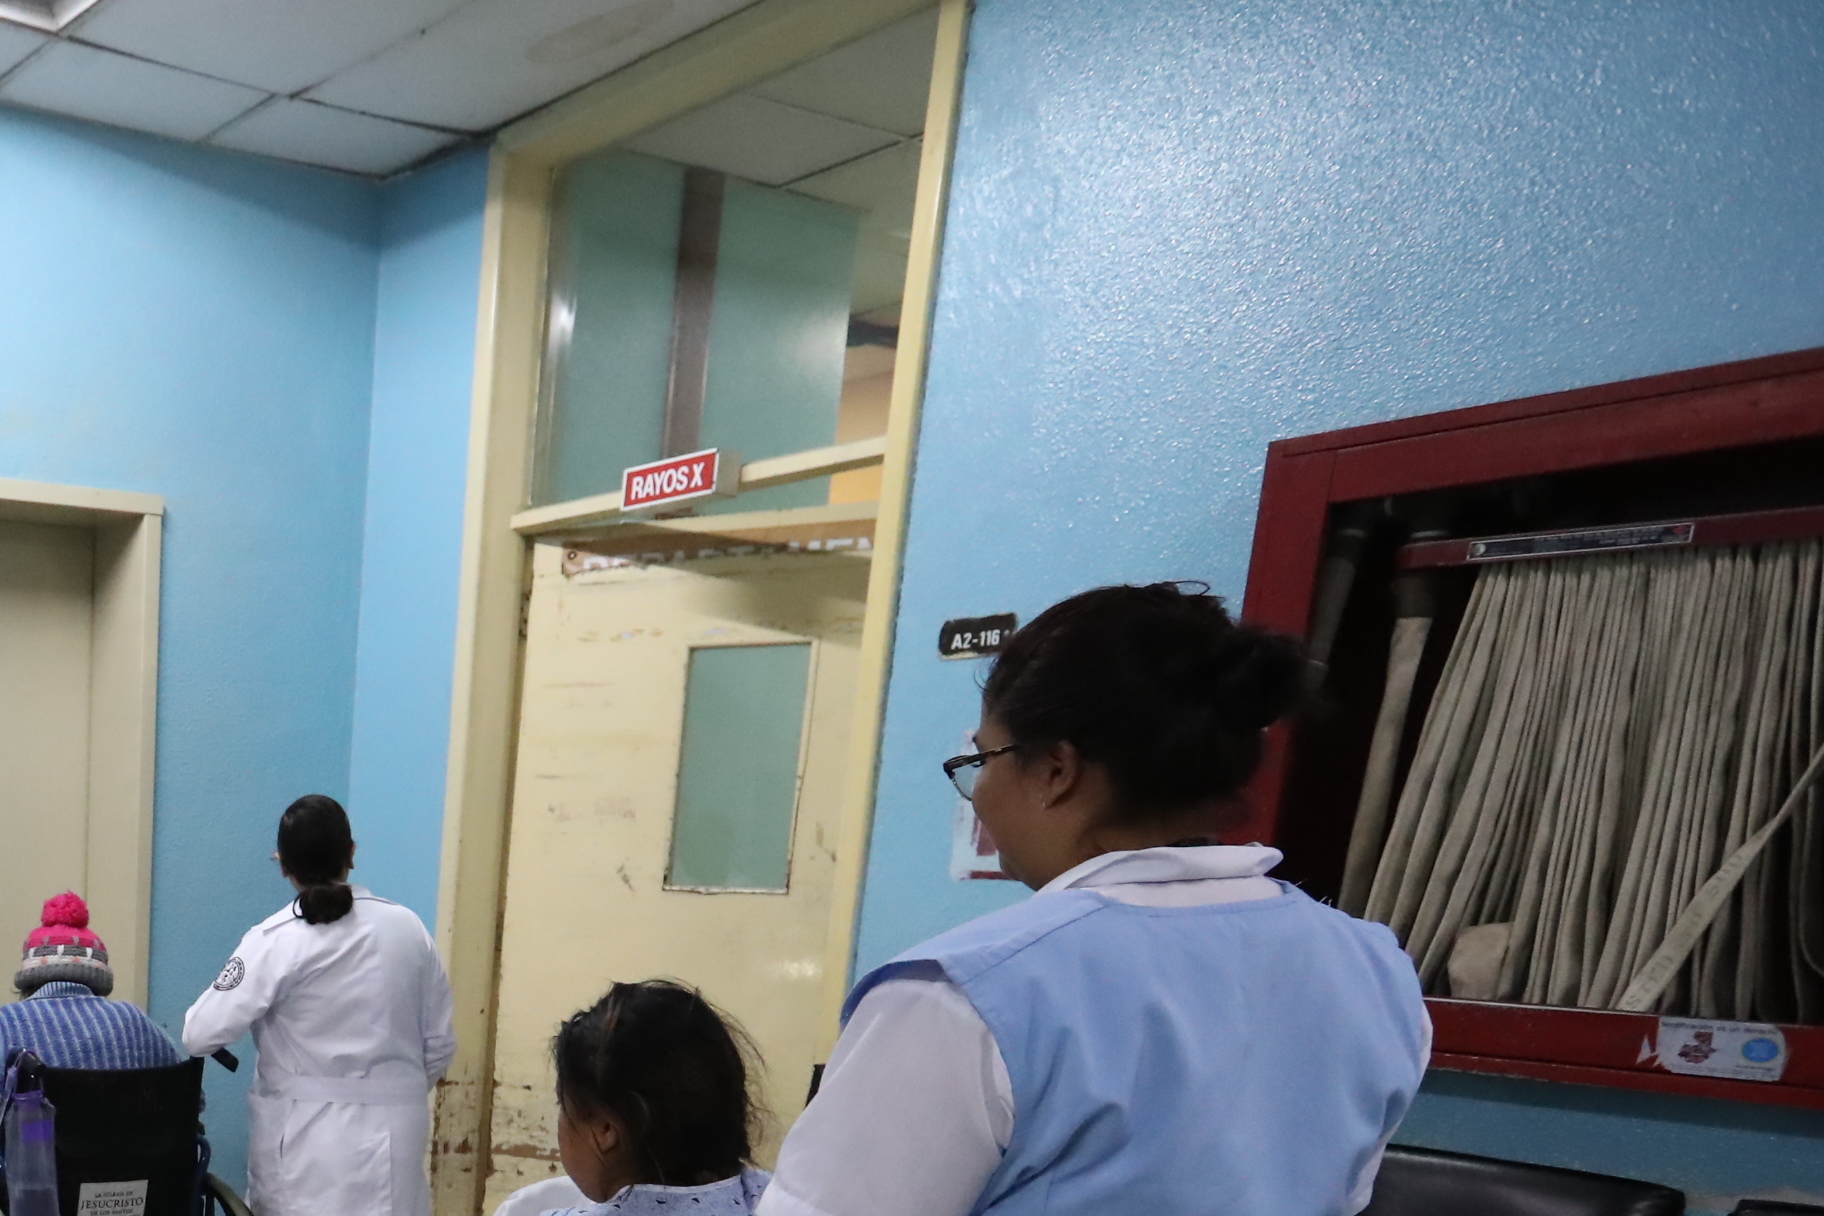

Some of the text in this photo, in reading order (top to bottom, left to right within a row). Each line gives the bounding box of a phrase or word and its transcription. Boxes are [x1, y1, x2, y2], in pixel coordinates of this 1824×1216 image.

[630, 462, 705, 500] RAYOS X
[81, 1197, 144, 1210] JESUCRISTO
